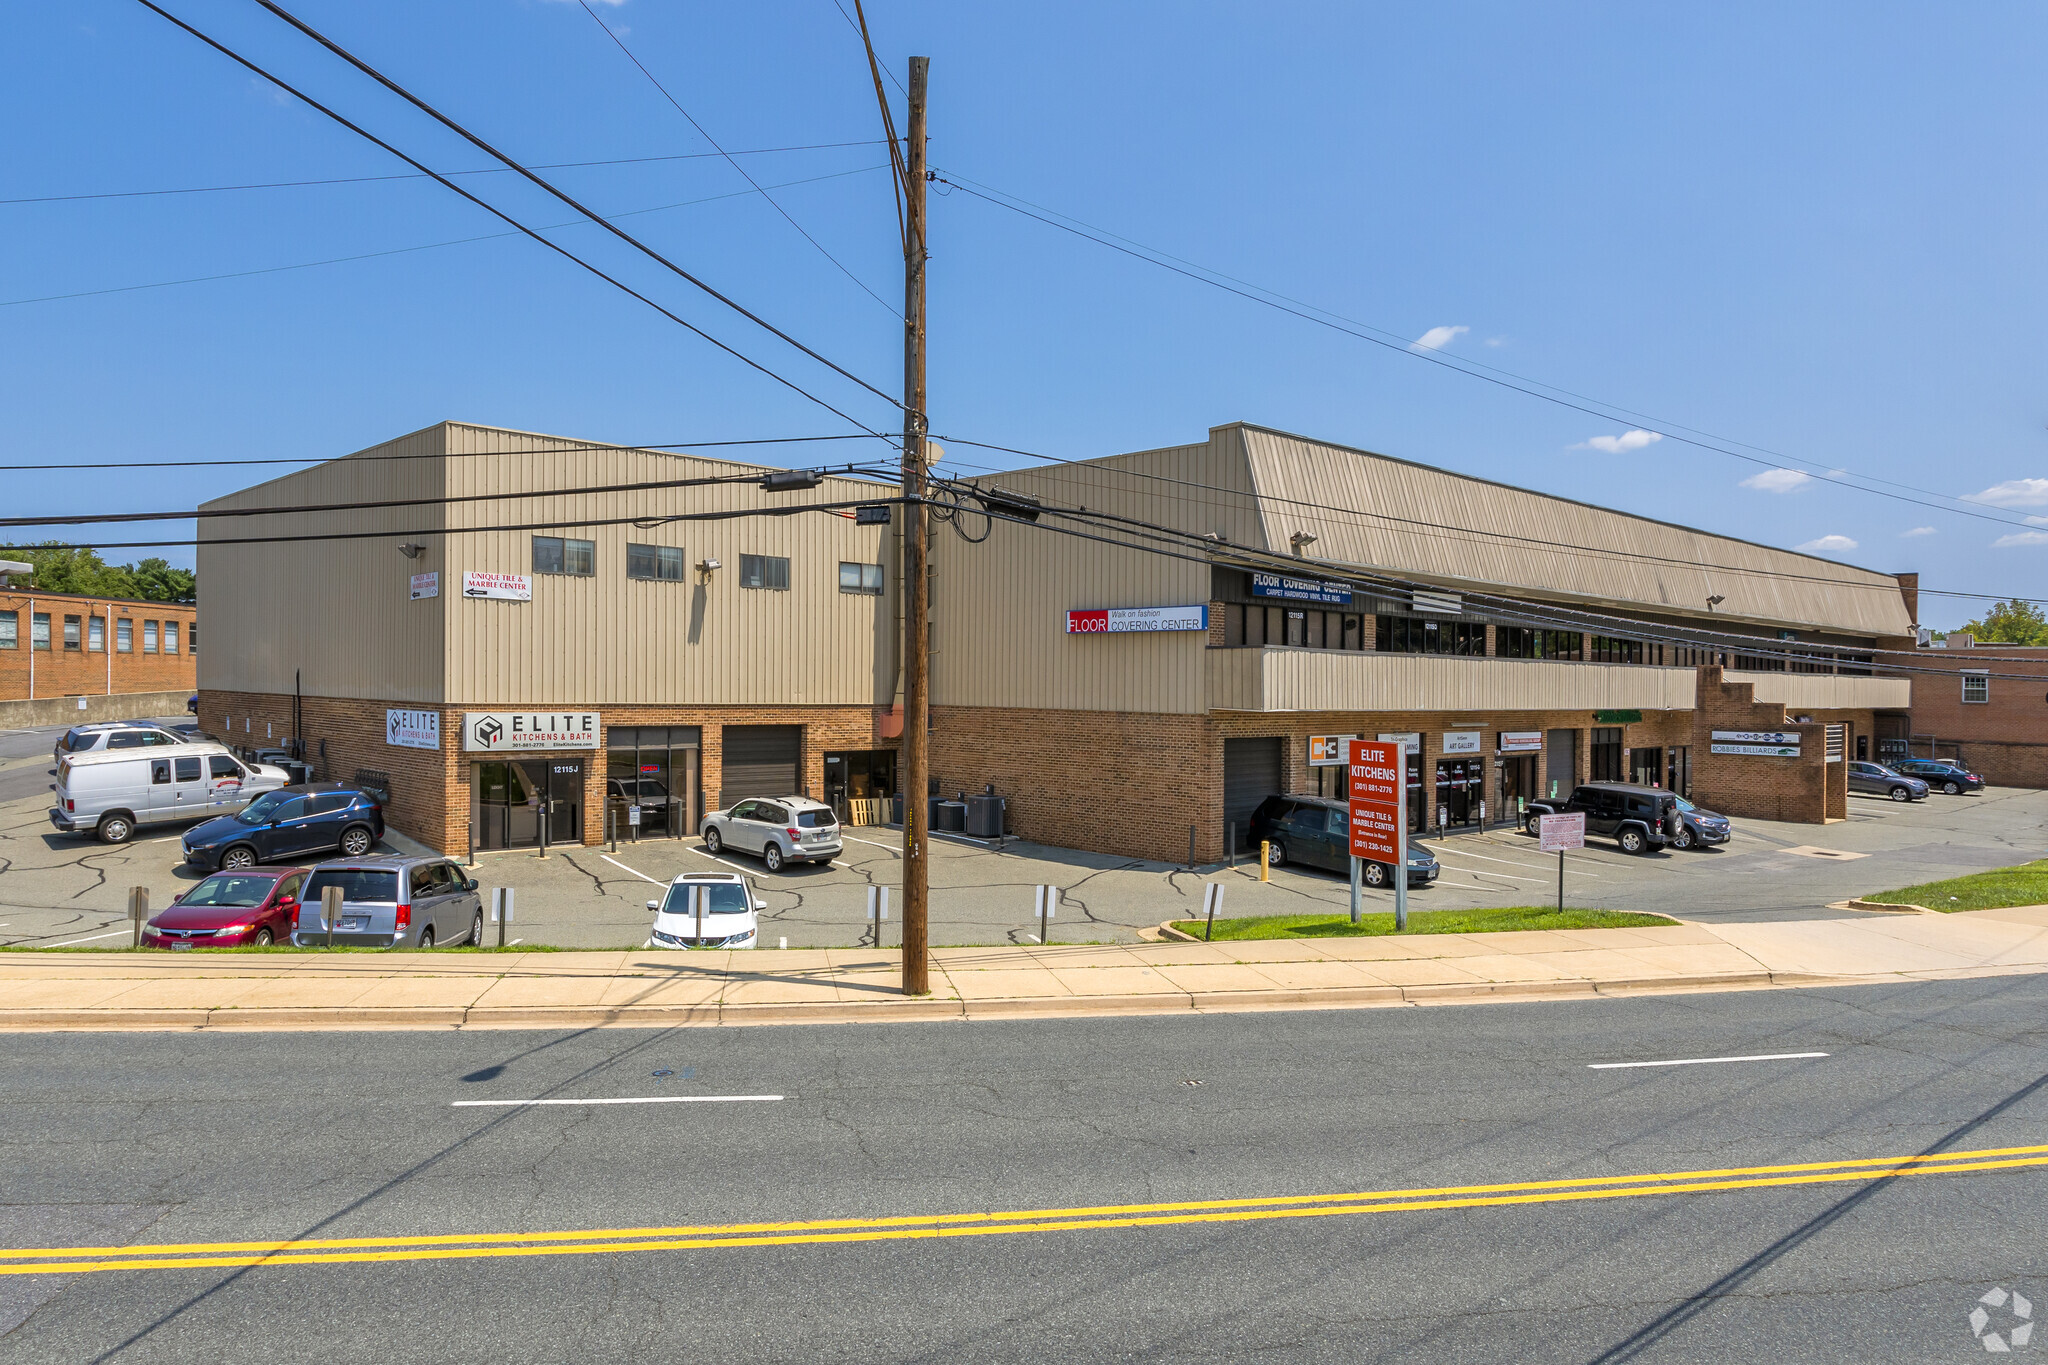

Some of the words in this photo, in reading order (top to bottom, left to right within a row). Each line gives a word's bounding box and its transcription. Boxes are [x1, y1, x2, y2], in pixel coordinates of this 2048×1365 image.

[472, 573, 500, 581] UNIQUE
[1253, 574, 1279, 587] FLOOR
[1283, 578, 1320, 591] COVERING
[1324, 581, 1351, 595] CENTER
[1266, 588, 1283, 596] CARPET
[1284, 590, 1308, 599] HARDWOOD
[1069, 619, 1106, 632] FLOOR
[1112, 620, 1158, 631] COVERING
[1162, 619, 1199, 629] CENTER
[402, 712, 435, 730] ELITE
[513, 715, 592, 732] ELITE
[402, 730, 420, 739] KITCHENS
[425, 732, 435, 740] BATH
[513, 733, 558, 741] KITCHENS
[1713, 745, 1740, 753] ROBBIES
[1361, 749, 1385, 762] ELITE
[554, 765, 578, 773] 12115J
[1352, 765, 1396, 781] KITCHENS
[1355, 782, 1367, 791] (301)
[1368, 784, 1392, 794] 881-2776
[1355, 809, 1375, 819] UNIQUE
[1376, 812, 1387, 820] TILE
[1353, 818, 1374, 828] MARBLE
[1375, 822, 1395, 831] CENTER
[1355, 840, 1367, 849] (301)
[1368, 842, 1392, 853] 230-1425
